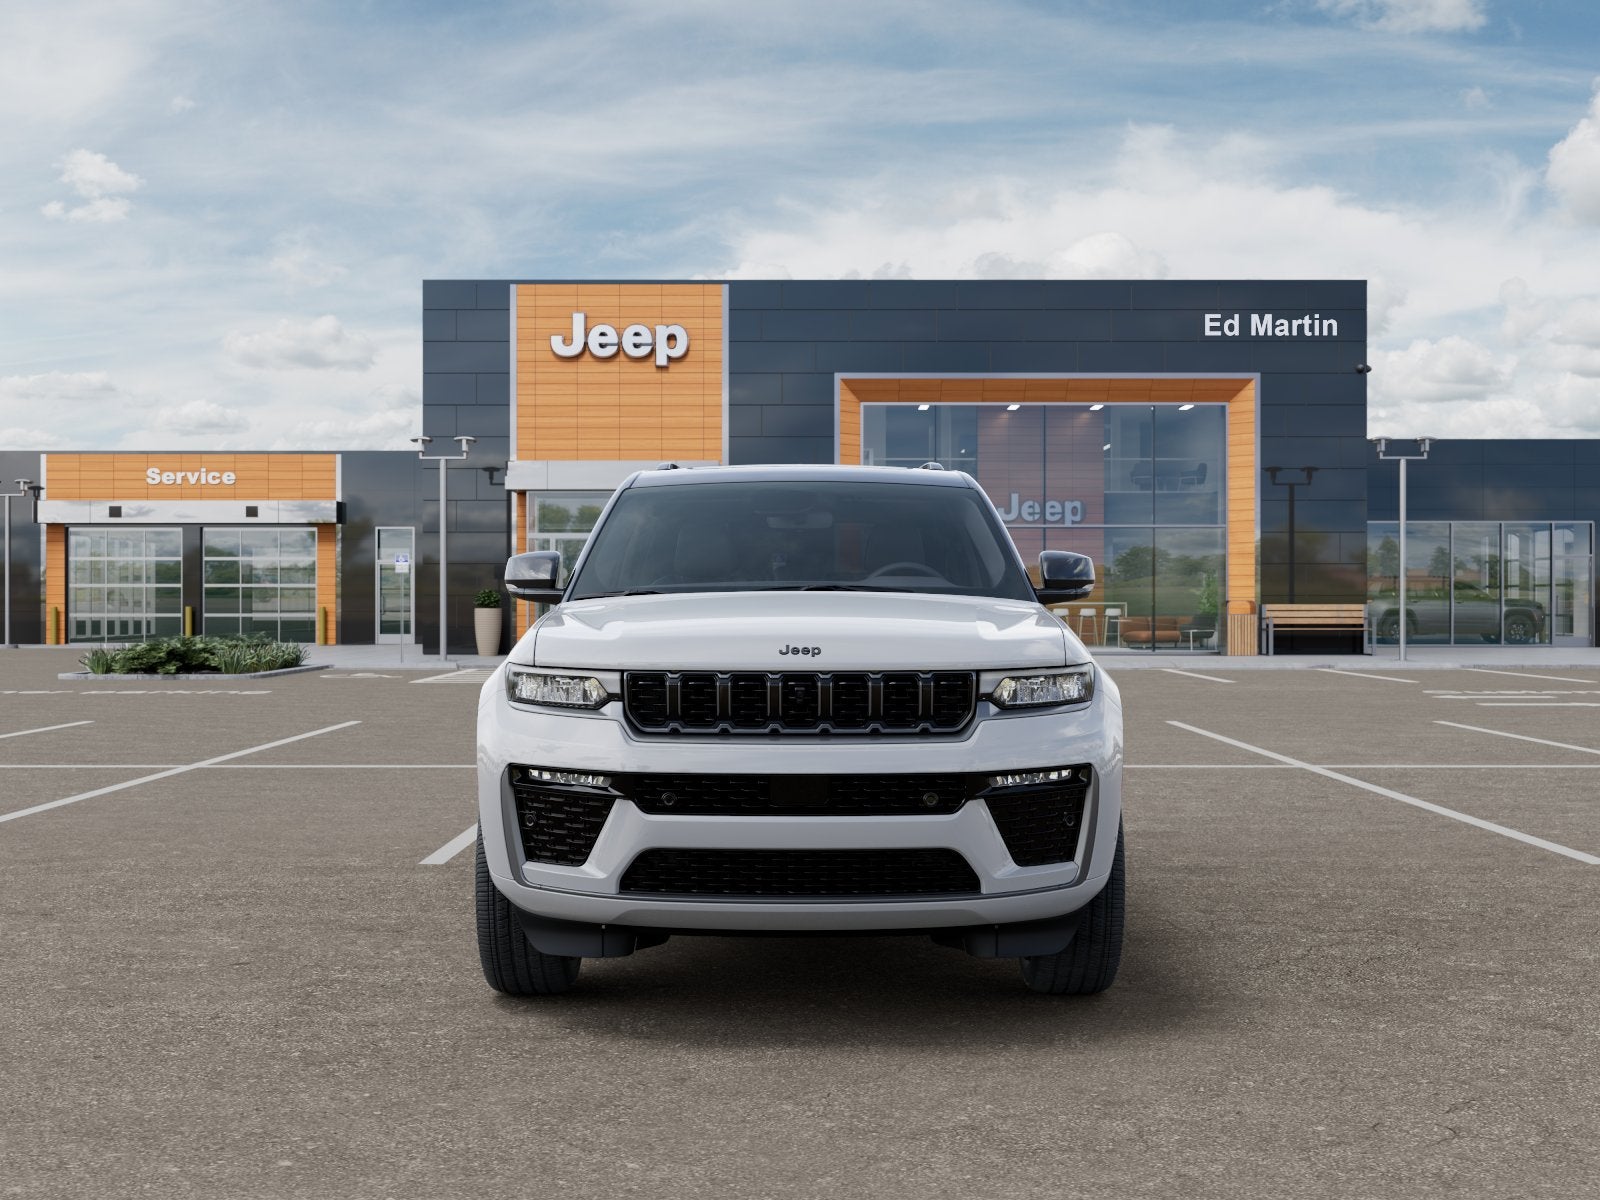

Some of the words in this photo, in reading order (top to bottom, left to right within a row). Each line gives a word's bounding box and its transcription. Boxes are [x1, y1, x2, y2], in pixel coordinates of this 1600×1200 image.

[1204, 314, 1240, 336] Ed
[1250, 314, 1338, 336] Martin
[550, 312, 689, 367] Jeep
[145, 467, 236, 485] Service
[997, 492, 1083, 524] Jeep
[778, 644, 822, 657] Jeep
